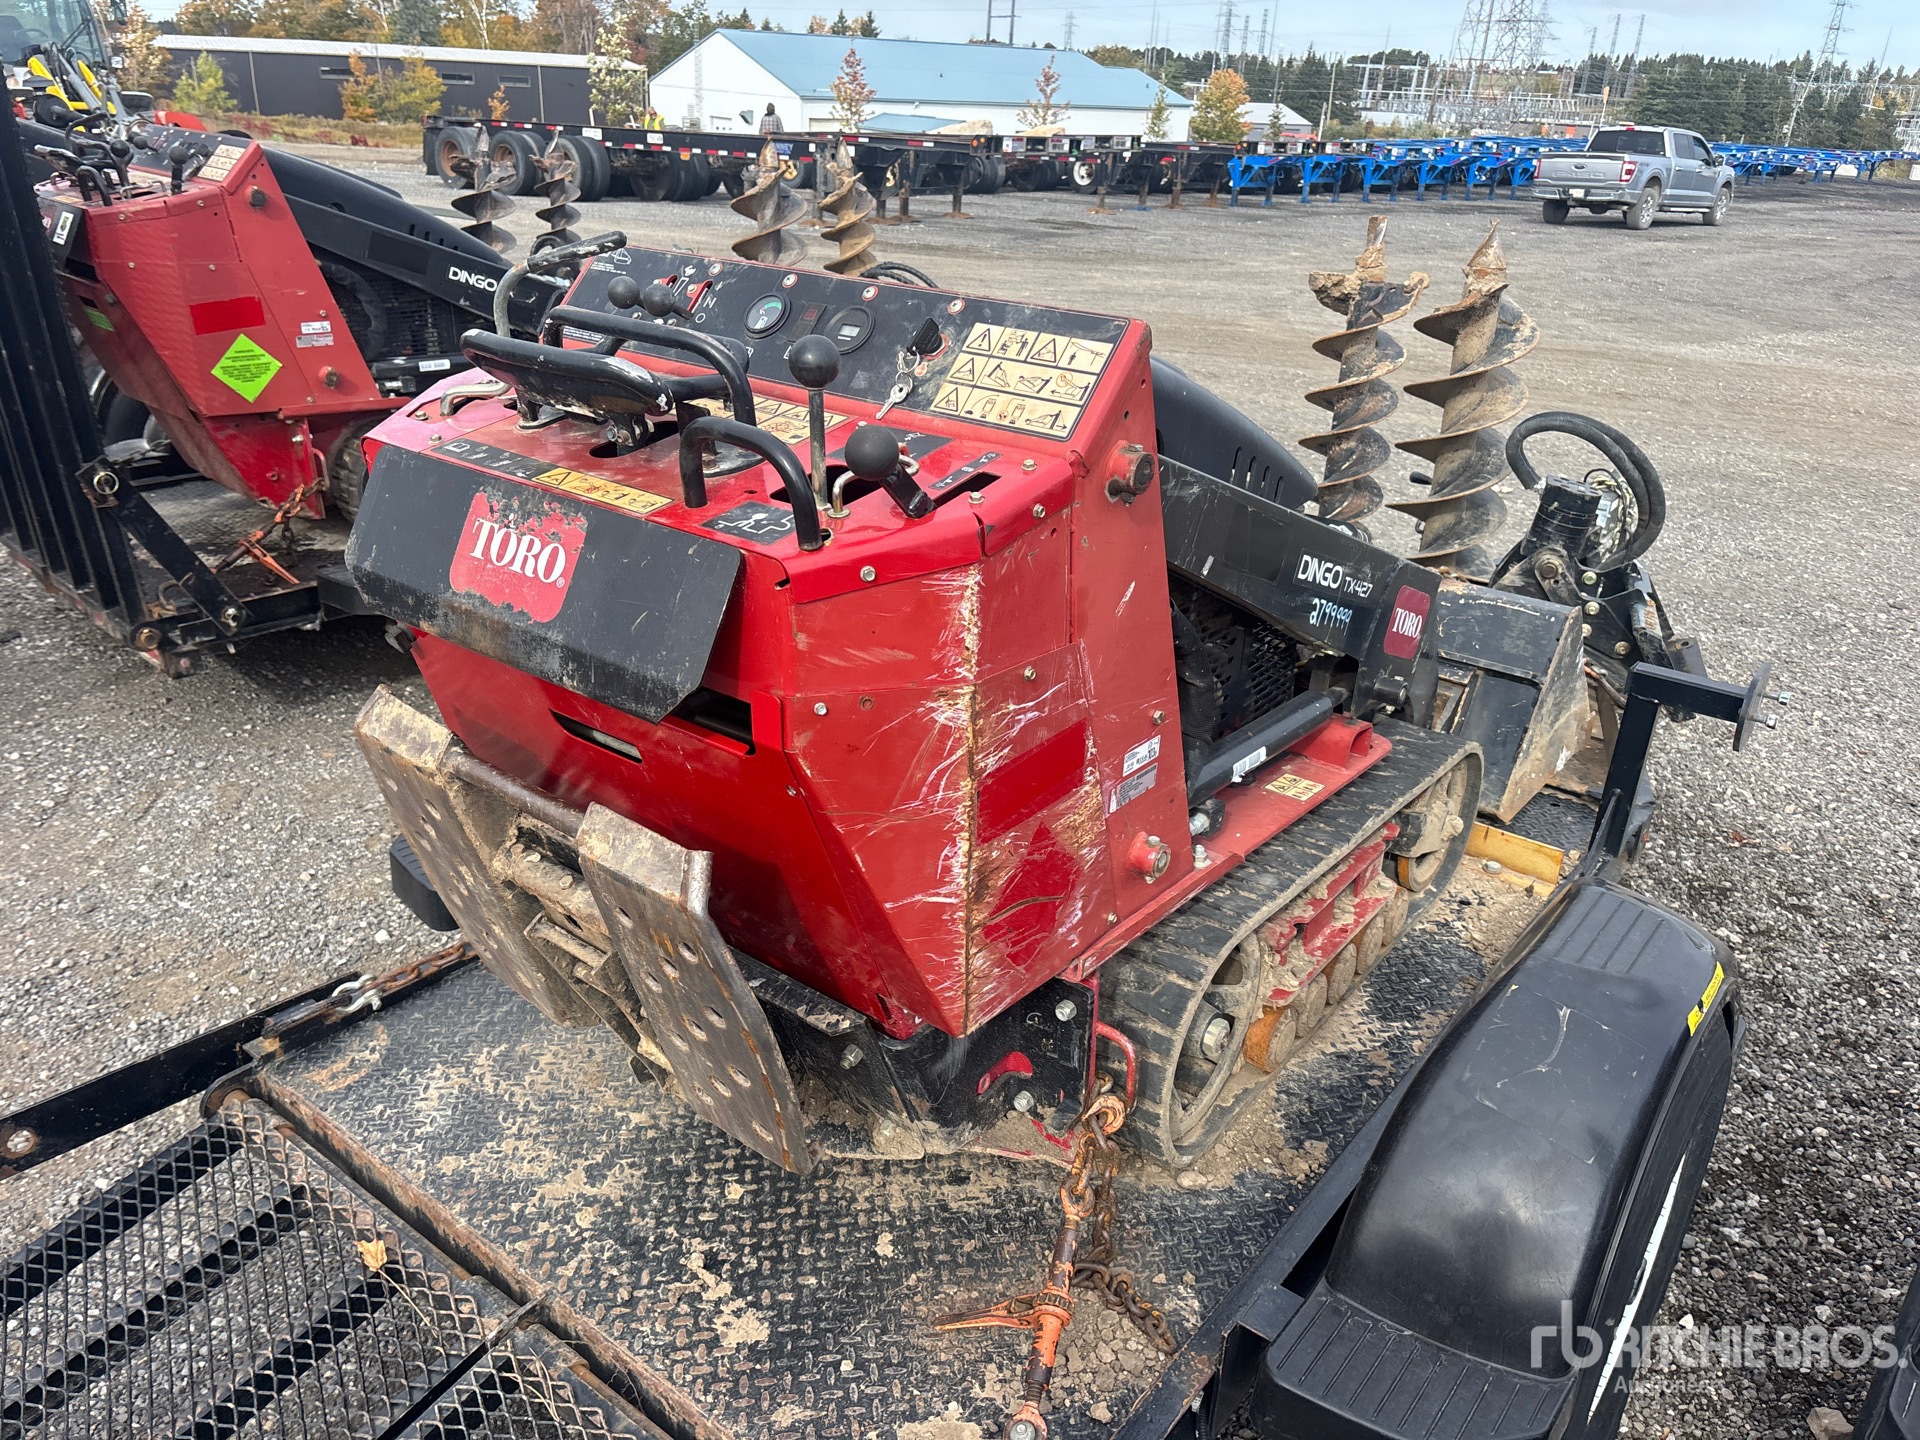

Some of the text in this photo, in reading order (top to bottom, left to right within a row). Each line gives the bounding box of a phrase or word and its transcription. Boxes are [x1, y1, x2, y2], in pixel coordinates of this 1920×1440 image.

[448, 266, 498, 292] DINGO
[1297, 554, 1343, 589] DINGO
[1391, 607, 1423, 639] TORO
